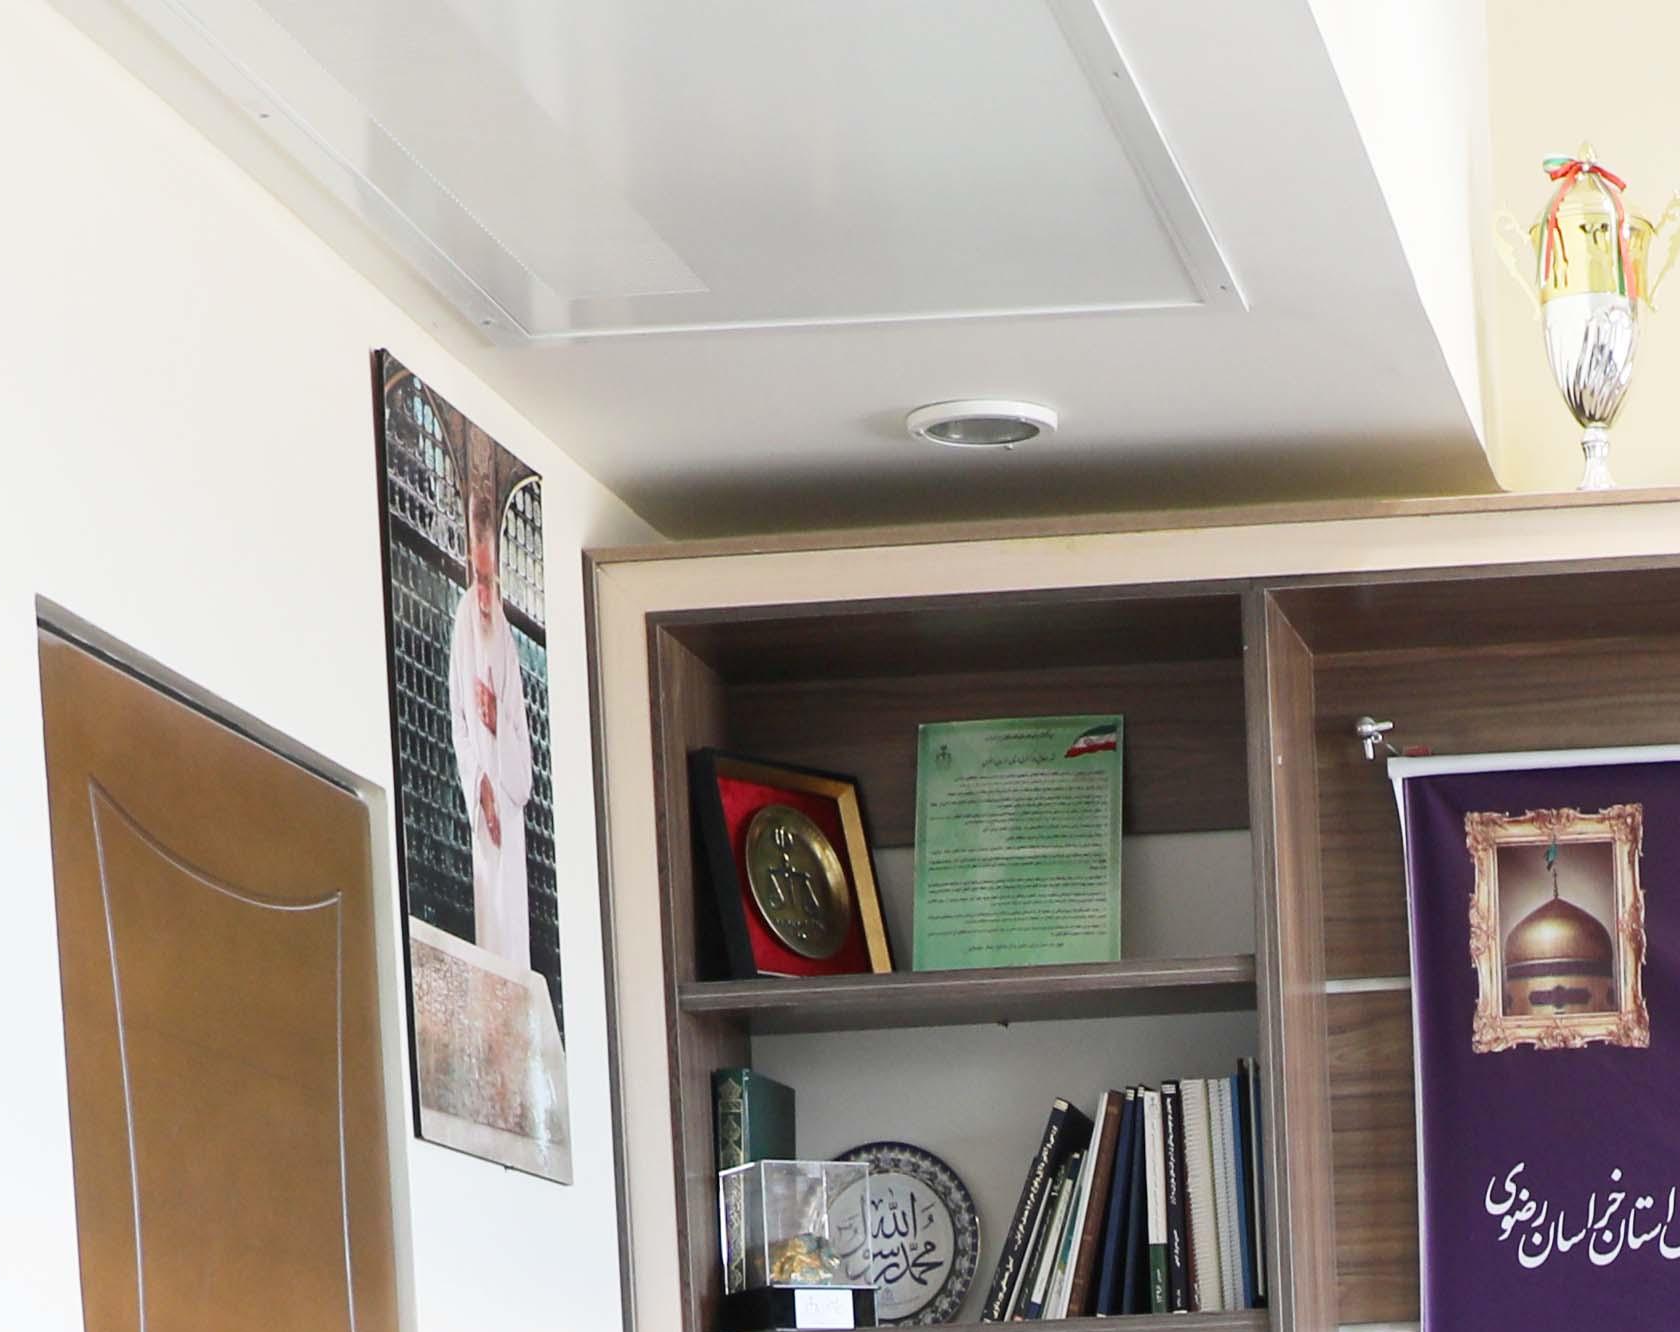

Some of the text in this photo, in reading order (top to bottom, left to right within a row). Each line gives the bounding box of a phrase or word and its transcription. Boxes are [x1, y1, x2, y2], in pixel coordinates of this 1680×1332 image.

[1485, 1162, 1548, 1241] رضوی
[1518, 1168, 1626, 1269] خراسان
[1589, 1186, 1676, 1266] استان
